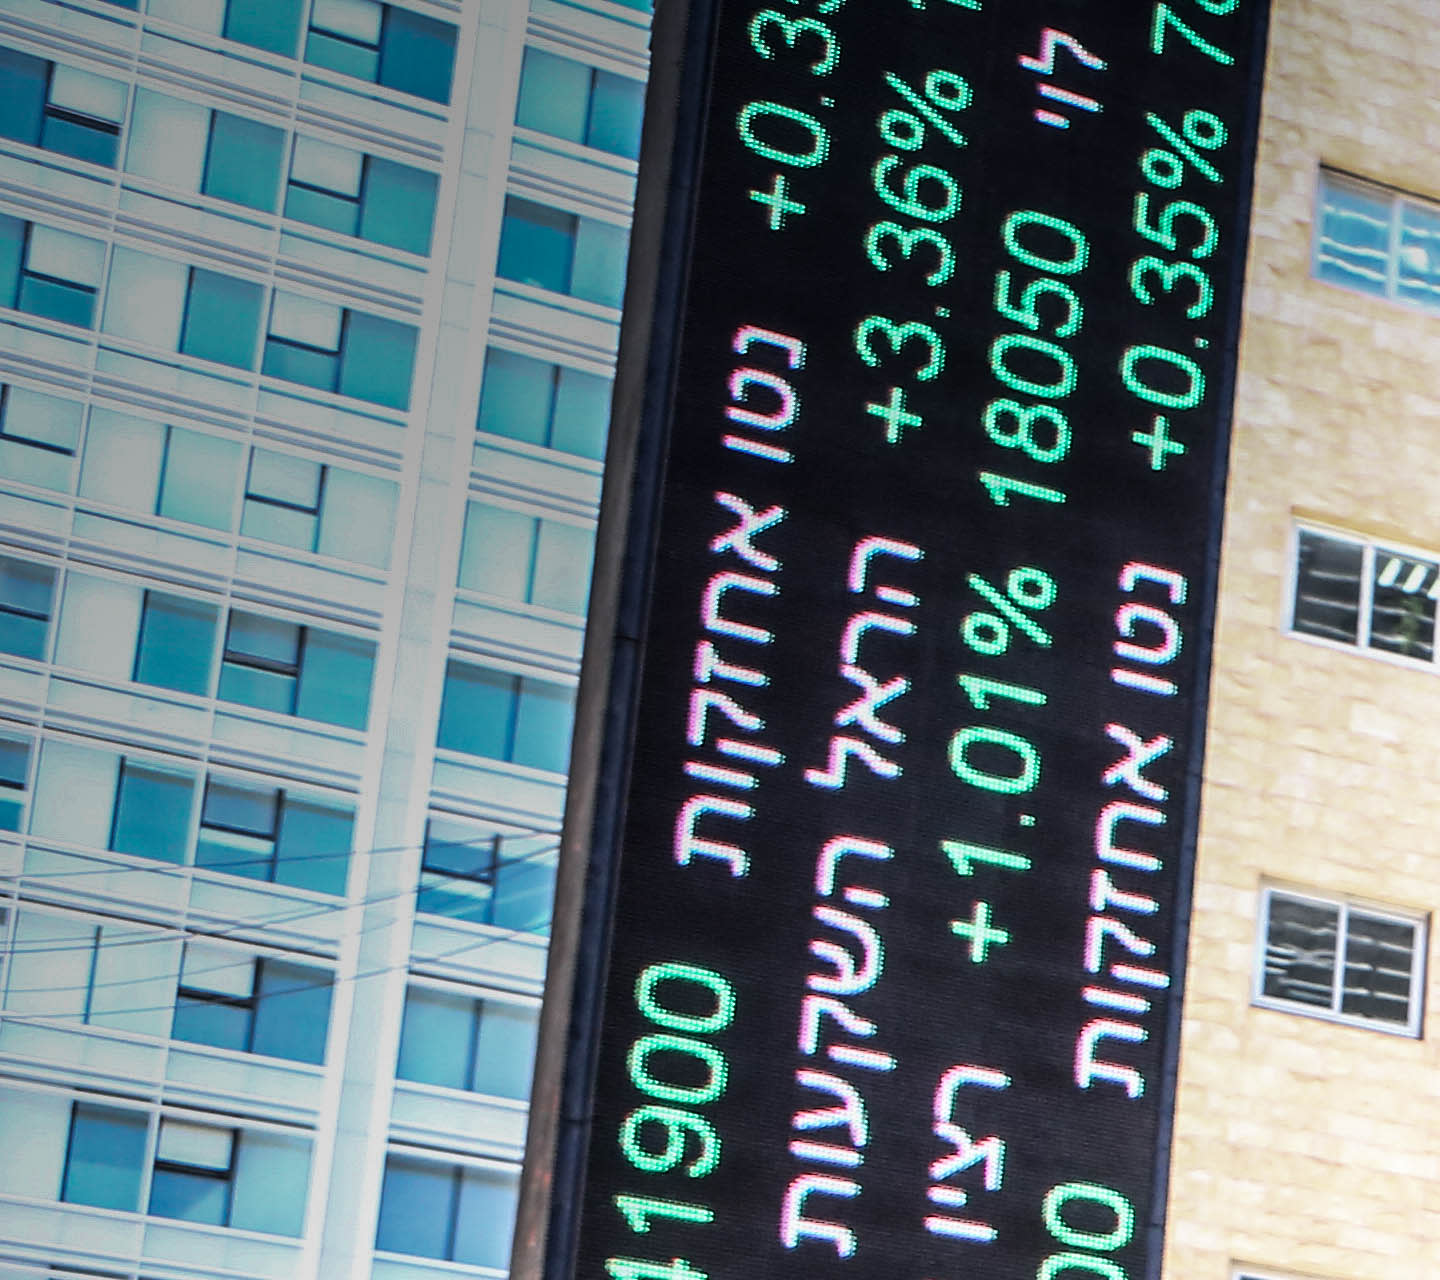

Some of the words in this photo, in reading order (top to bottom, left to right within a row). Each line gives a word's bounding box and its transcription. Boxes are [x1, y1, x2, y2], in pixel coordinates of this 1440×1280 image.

[737, 0, 846, 230] +0.3
[1019, 28, 1107, 128] לוי
[723, 325, 807, 463] נטו
[854, 70, 973, 443] +3.36%
[980, 211, 1090, 506] 18050
[1119, 110, 1228, 470] +0.35%
[674, 492, 789, 879] אחזקות
[804, 536, 925, 791] הראל
[941, 567, 1057, 963] +1.01%
[1110, 561, 1187, 697] נטו
[779, 834, 898, 1260] השקעות
[1073, 723, 1171, 1101] אחזקות
[923, 1063, 1011, 1244] רציו
